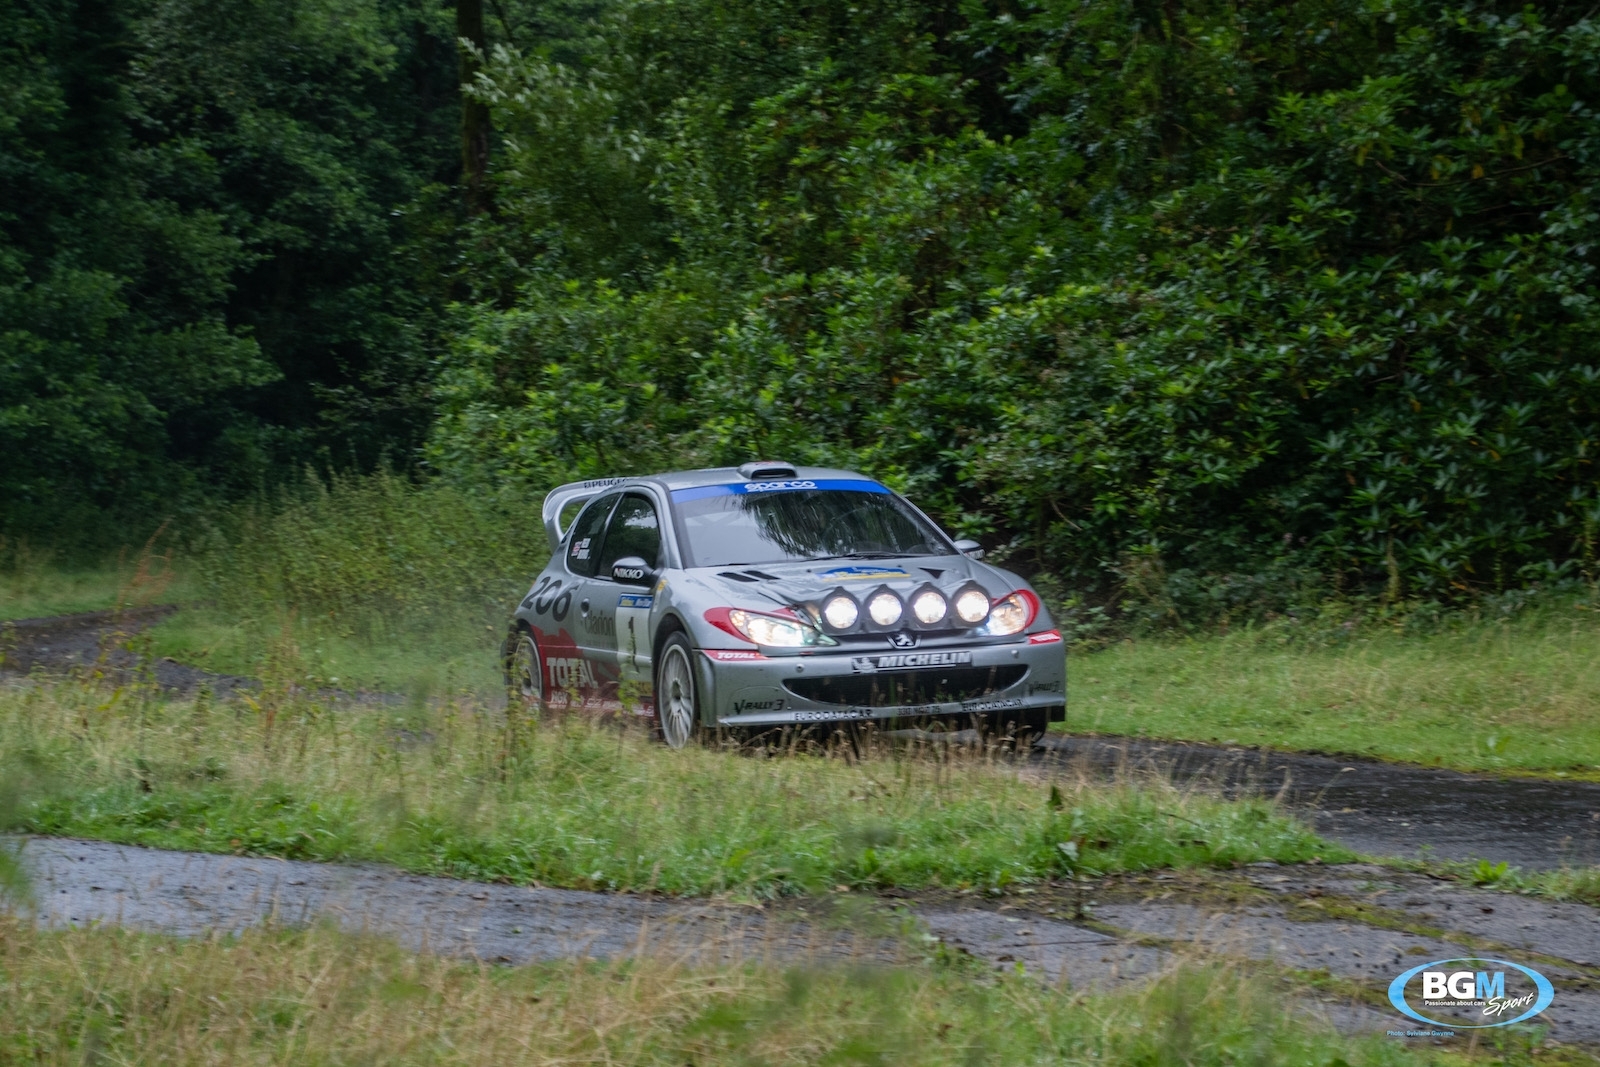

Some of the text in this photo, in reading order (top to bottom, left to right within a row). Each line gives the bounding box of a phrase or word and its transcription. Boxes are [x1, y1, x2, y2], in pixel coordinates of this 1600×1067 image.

[744, 480, 818, 493] sparco
[613, 567, 645, 580] NIKKO
[521, 577, 578, 621] 206
[717, 651, 756, 659] TOTAL
[877, 651, 973, 668] MICHELIN
[546, 657, 599, 689] TOTAL
[773, 699, 785, 711] 3
[794, 709, 874, 721] EURODATACAR
